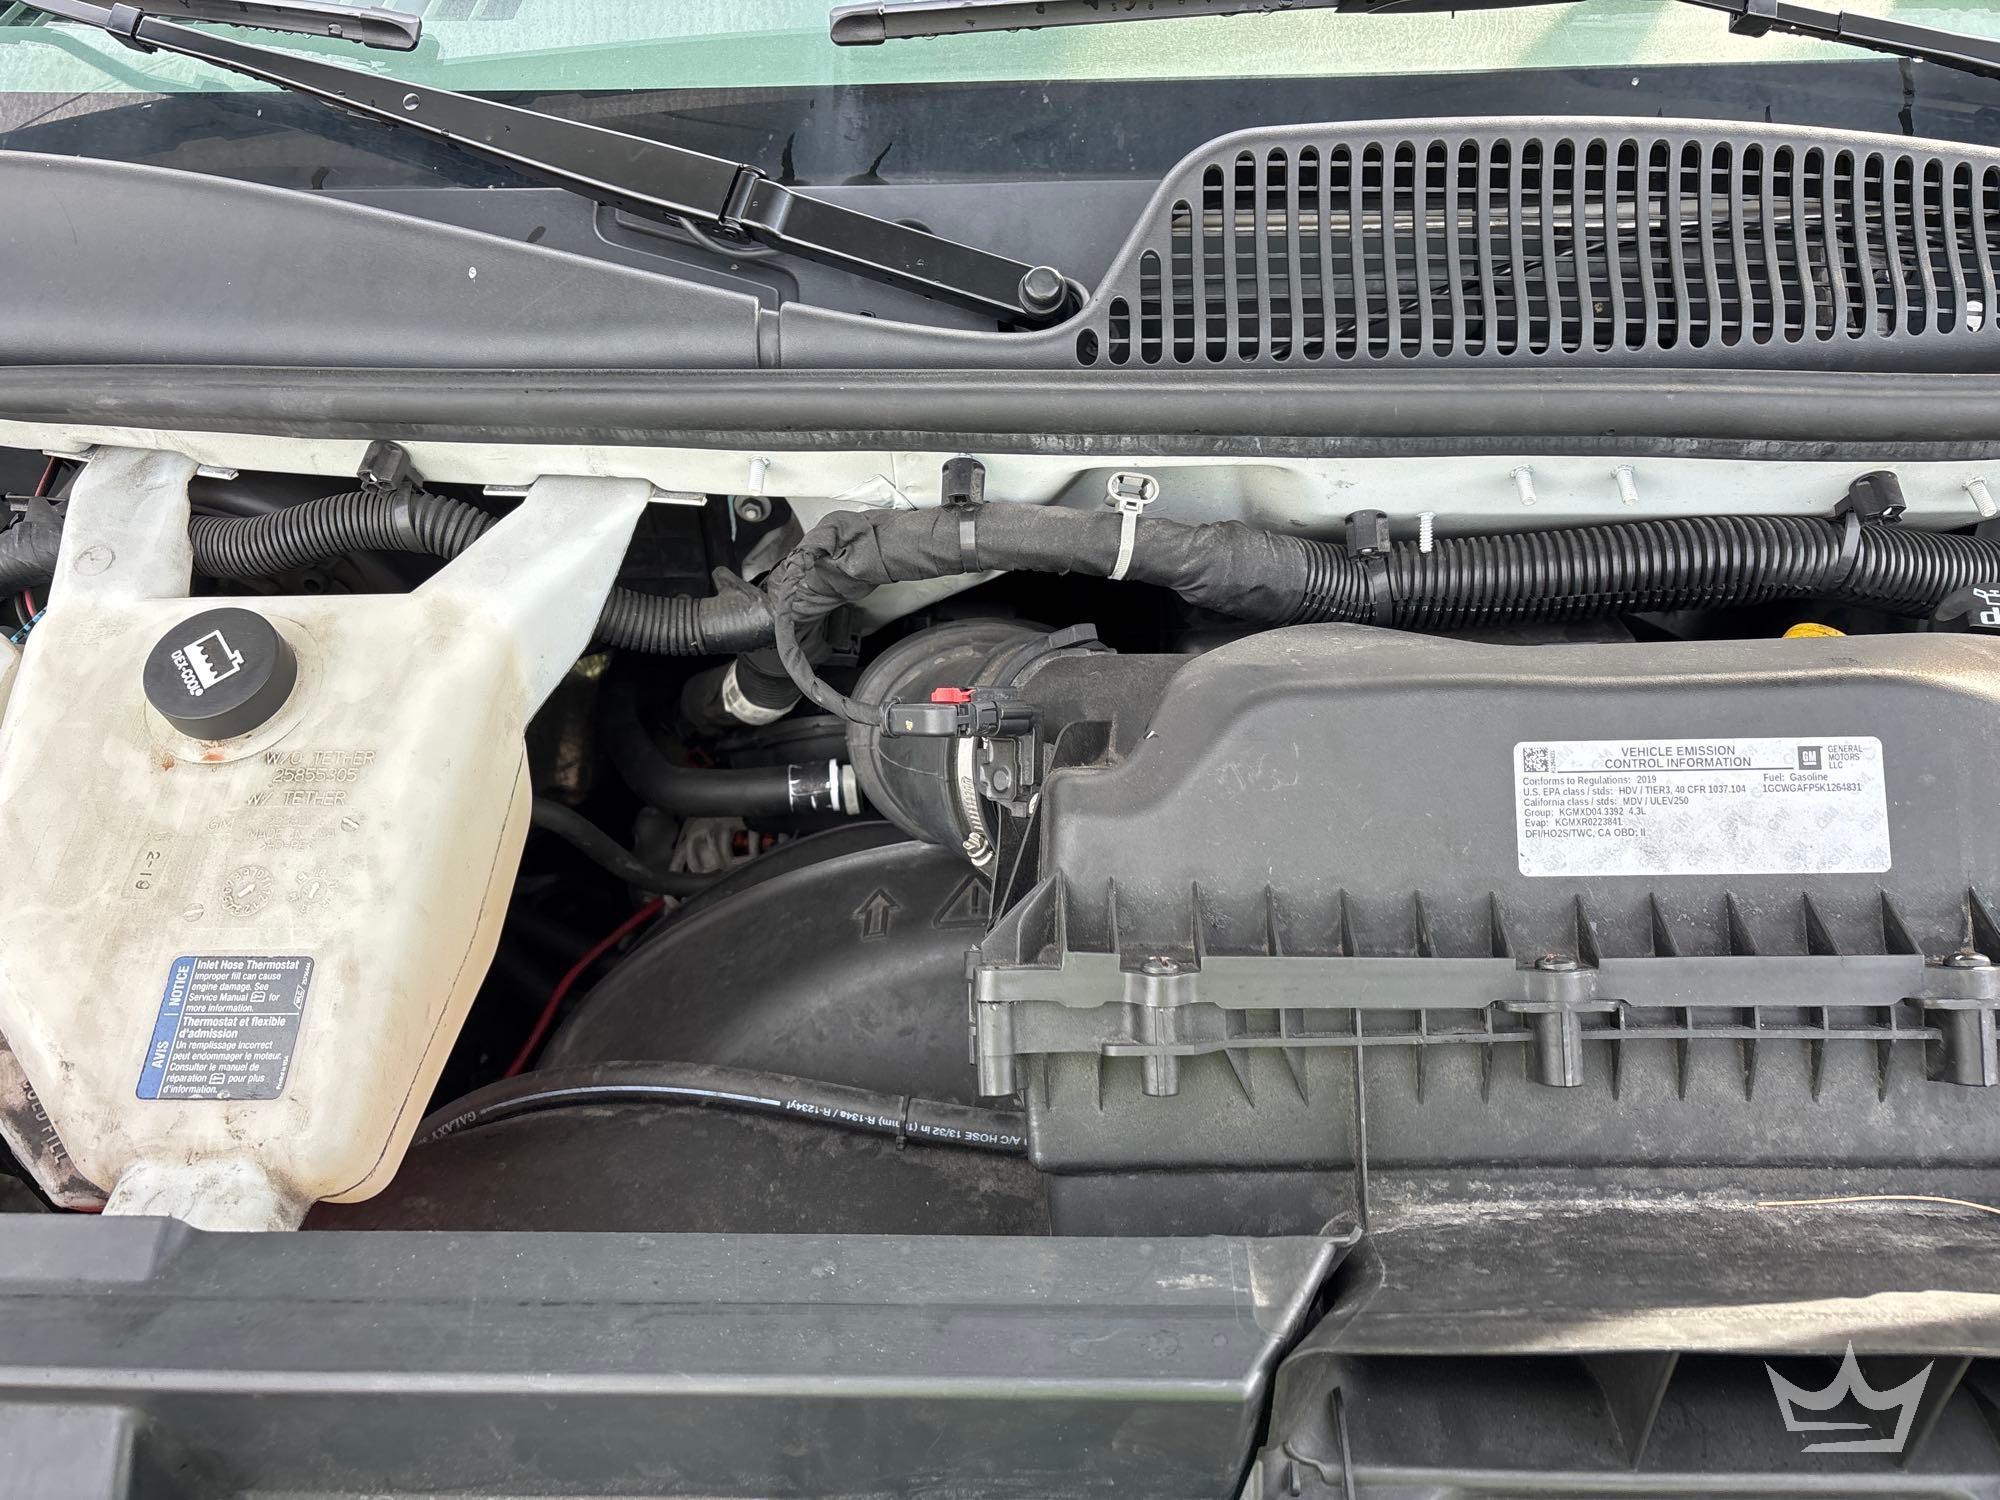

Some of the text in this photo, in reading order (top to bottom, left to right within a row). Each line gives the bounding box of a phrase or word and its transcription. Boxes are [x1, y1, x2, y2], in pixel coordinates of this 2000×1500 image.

[1621, 745, 1736, 757] VEHICLE EMISSION
[1827, 744, 1863, 753] GENERAL
[265, 750, 376, 765] W/O TETHER
[1802, 751, 1817, 762] GM
[1828, 753, 1860, 761] MOTORS
[1604, 757, 1751, 769] CONTROL INFORMATION
[1828, 761, 1843, 769] LLC
[1522, 775, 1657, 787] Conforms to Regulations: 2019
[1763, 772, 1828, 782] Fuel: Gasoline
[1523, 788, 1540, 796] U.S.
[1542, 788, 1561, 796] EPA
[1563, 788, 1586, 796] class
[1592, 786, 1614, 796] stds:
[1618, 786, 1638, 795] HDV
[1645, 786, 1673, 796] TIER3,
[1675, 786, 1685, 794] 40
[1687, 785, 1706, 794] CFR
[1708, 785, 1746, 794] 1037.104
[246, 791, 347, 806] W/ TETHER
[1524, 798, 1565, 807] California
[1567, 797, 1589, 806] class
[1596, 796, 1617, 806] stds:
[1622, 796, 1642, 805] MDV
[1650, 796, 1689, 805] ULEV250
[1524, 806, 1646, 818] Group: KGMXD04.3392 4.3L
[1525, 818, 1623, 828] Evap: KGMXR0223841
[1598, 828, 1611, 837] CA
[197, 960, 300, 970] Inlet Hose Thermostat
[194, 972, 282, 982] Improper fill can cause
[168, 965, 190, 1006] NOTICE
[192, 982, 270, 991] engine damage. See
[189, 993, 280, 1002] Service Manual for
[186, 1004, 254, 1012] more information.
[183, 1016, 286, 1026] Thermostat et flexible
[179, 1028, 238, 1038] d'admission
[176, 1040, 273, 1050] Un remplissage incorrect
[152, 1040, 170, 1068] AVIS
[172, 1052, 282, 1061] peut endommager le moteur.
[170, 1063, 260, 1072] Consulter le manuel de
[166, 1073, 266, 1083] réparation pour plus
[162, 1084, 218, 1094] d'information.
[840, 1110, 876, 1126] R-134a
[920, 1124, 931, 1135] in
[932, 1125, 962, 1139] 13/32
[964, 1131, 999, 1144] HOSE
[1000, 1134, 1020, 1146] A/C
